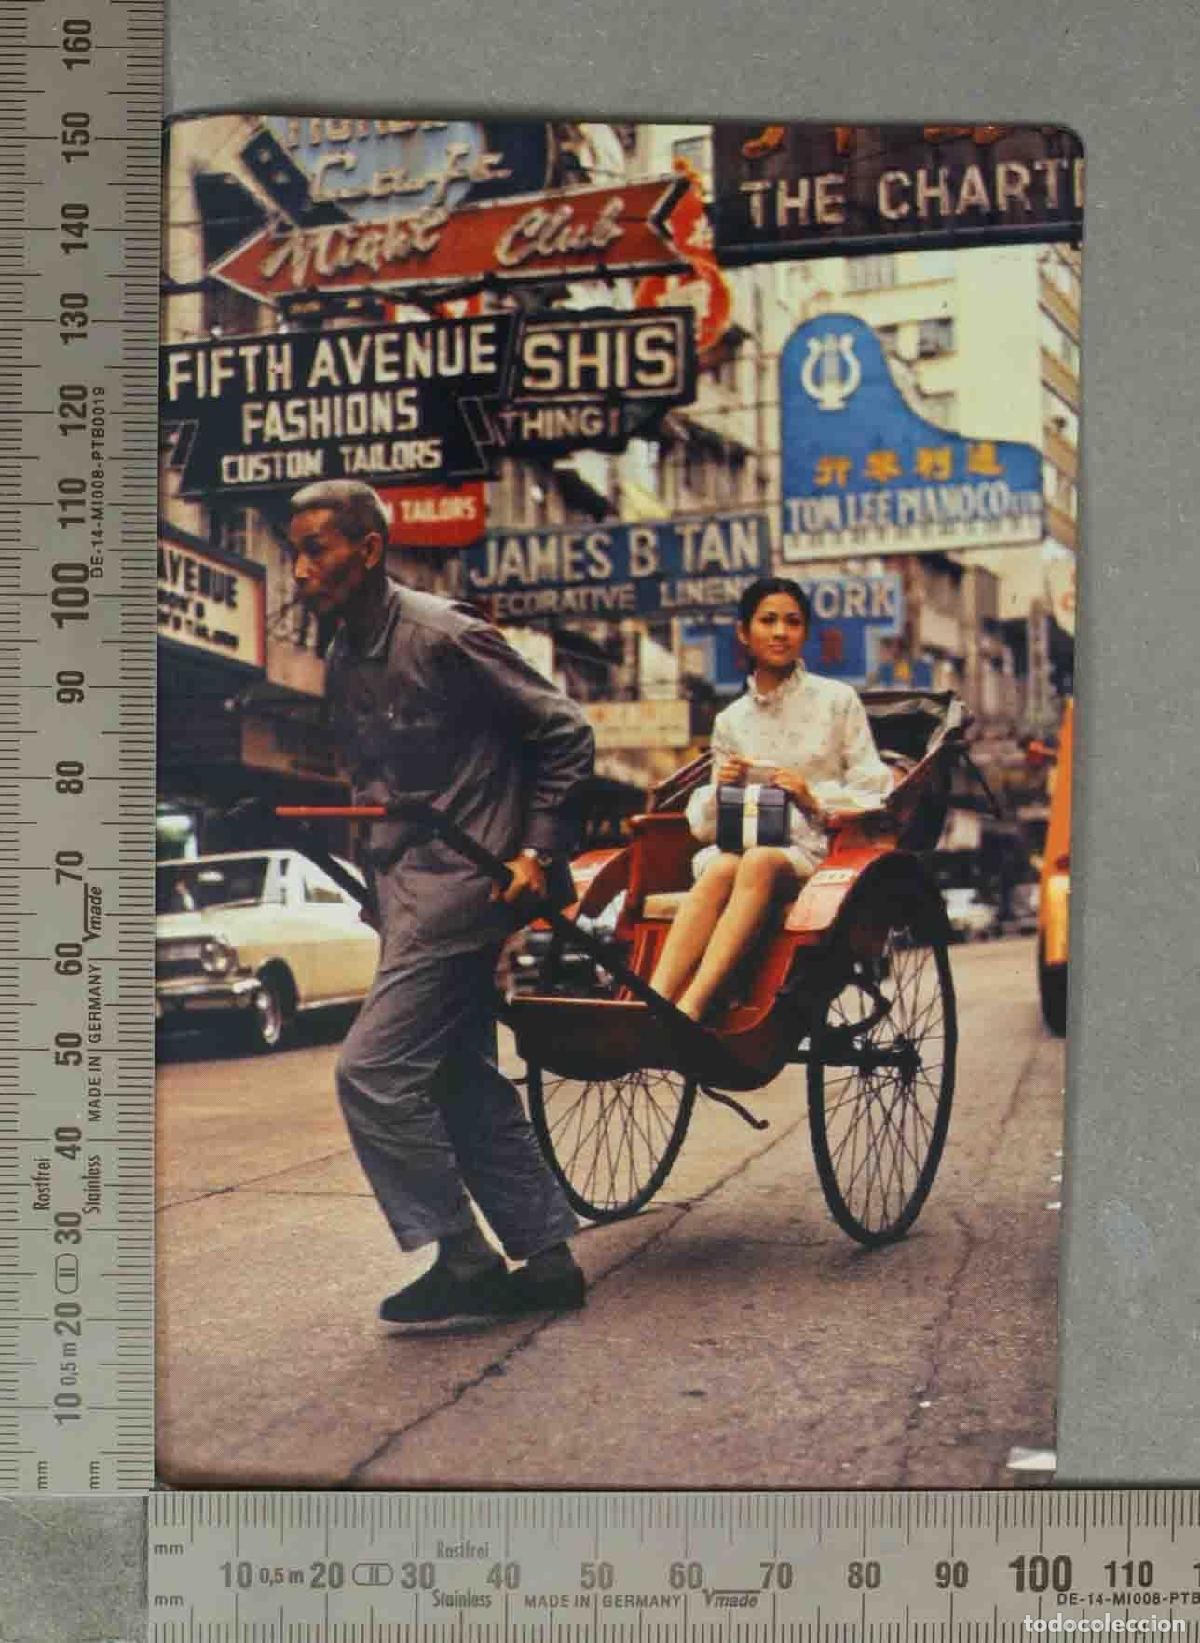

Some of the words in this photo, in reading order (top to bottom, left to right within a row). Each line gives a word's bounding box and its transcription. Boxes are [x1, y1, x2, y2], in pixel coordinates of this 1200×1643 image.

[62, 18, 92, 70] 160
[61, 111, 91, 163] 150
[739, 171, 846, 229] THE
[60, 203, 90, 254] 140
[493, 198, 626, 267] Club
[59, 292, 90, 345] 130
[168, 343, 293, 401] FIFTH
[307, 323, 498, 388] AVENUE
[522, 325, 676, 391] SHIS
[58, 384, 88, 437] 120
[241, 387, 418, 445] FASHIONS
[221, 449, 323, 484] CUSTOM
[339, 439, 443, 474] TAILORS
[57, 477, 87, 529] 110
[469, 532, 613, 588] JAMES
[628, 527, 658, 577] B
[674, 518, 760, 572] TAN
[50, 562, 90, 629] 100
[55, 670, 85, 704] 90
[55, 760, 85, 795] 80
[55, 850, 83, 886] 70
[54, 942, 83, 976] 60
[88, 964, 102, 1044] GERMANY
[54, 1032, 82, 1067] 50
[88, 1056, 101, 1075] IN
[88, 1077, 101, 1122] MADE
[54, 1126, 82, 1162] 40
[33, 1157, 51, 1211] Rostfrei
[82, 1154, 101, 1216] Stainless
[53, 1211, 82, 1246] 30
[53, 1302, 82, 1336] 20
[53, 1392, 82, 1425] 10
[37, 1460, 49, 1490] mm
[89, 1460, 102, 1490] mm
[153, 1542, 185, 1557] mm
[220, 1561, 253, 1590] 10
[309, 1561, 345, 1590] 20
[400, 1561, 436, 1590] 30
[486, 1561, 522, 1590] 40
[579, 1561, 615, 1590] 50
[668, 1561, 704, 1590] 60
[759, 1561, 793, 1590] 70
[847, 1561, 882, 1590] 80
[934, 1561, 969, 1590] 90
[1008, 1555, 1073, 1593] 100
[1104, 1560, 1153, 1588] 110
[153, 1594, 185, 1609] mm
[431, 1588, 493, 1609] Stainless
[524, 1594, 567, 1609] MADE
[571, 1594, 590, 1609] IN
[602, 1594, 682, 1609] GERMANY
